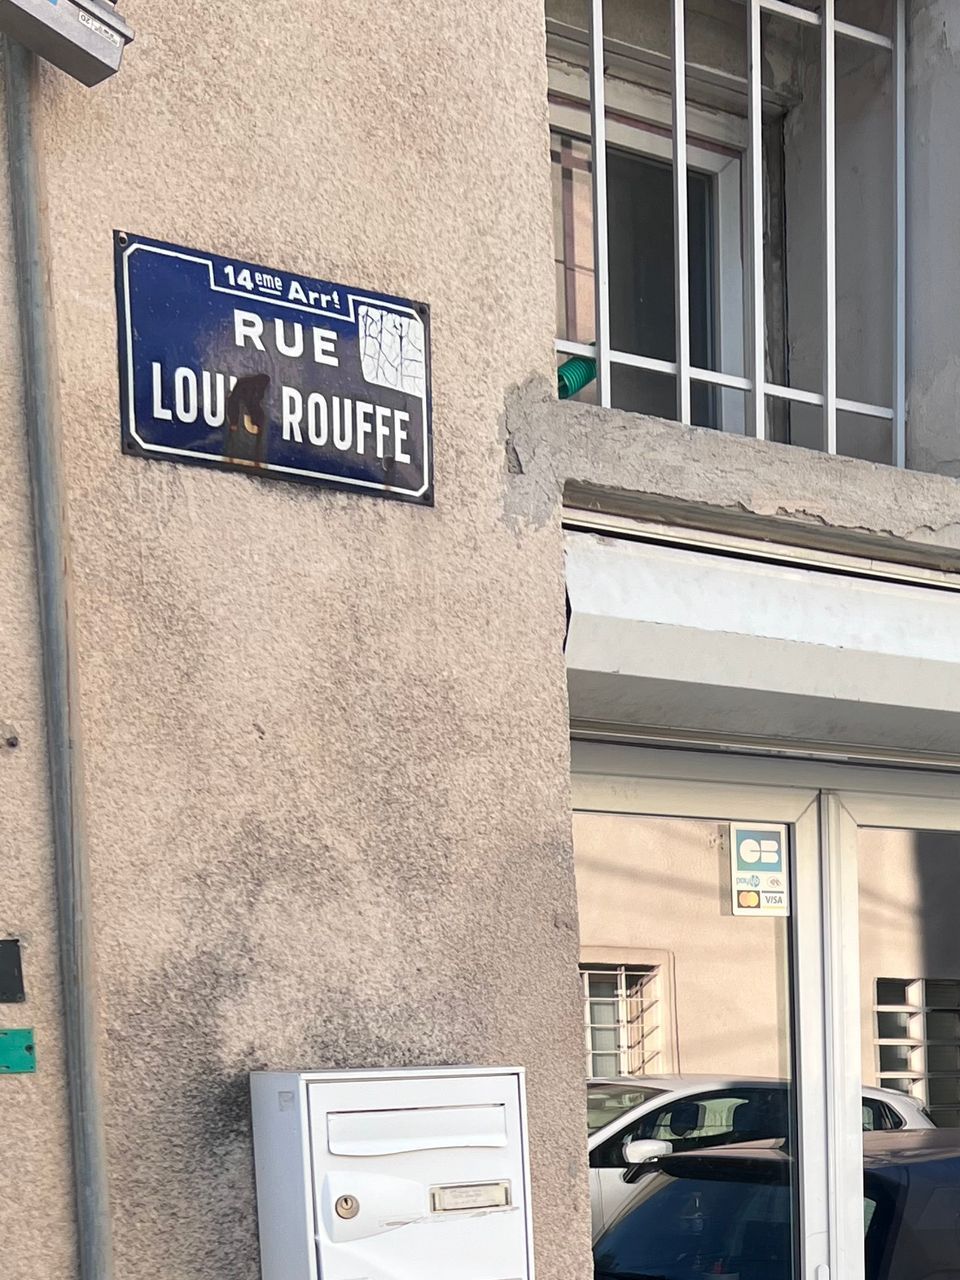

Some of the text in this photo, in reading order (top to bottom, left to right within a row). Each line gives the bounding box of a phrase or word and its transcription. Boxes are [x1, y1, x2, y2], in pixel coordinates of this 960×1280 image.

[233, 309, 340, 367] RUE
[151, 362, 411, 465] LOU ROUFFE
[765, 895, 783, 904] VISA
